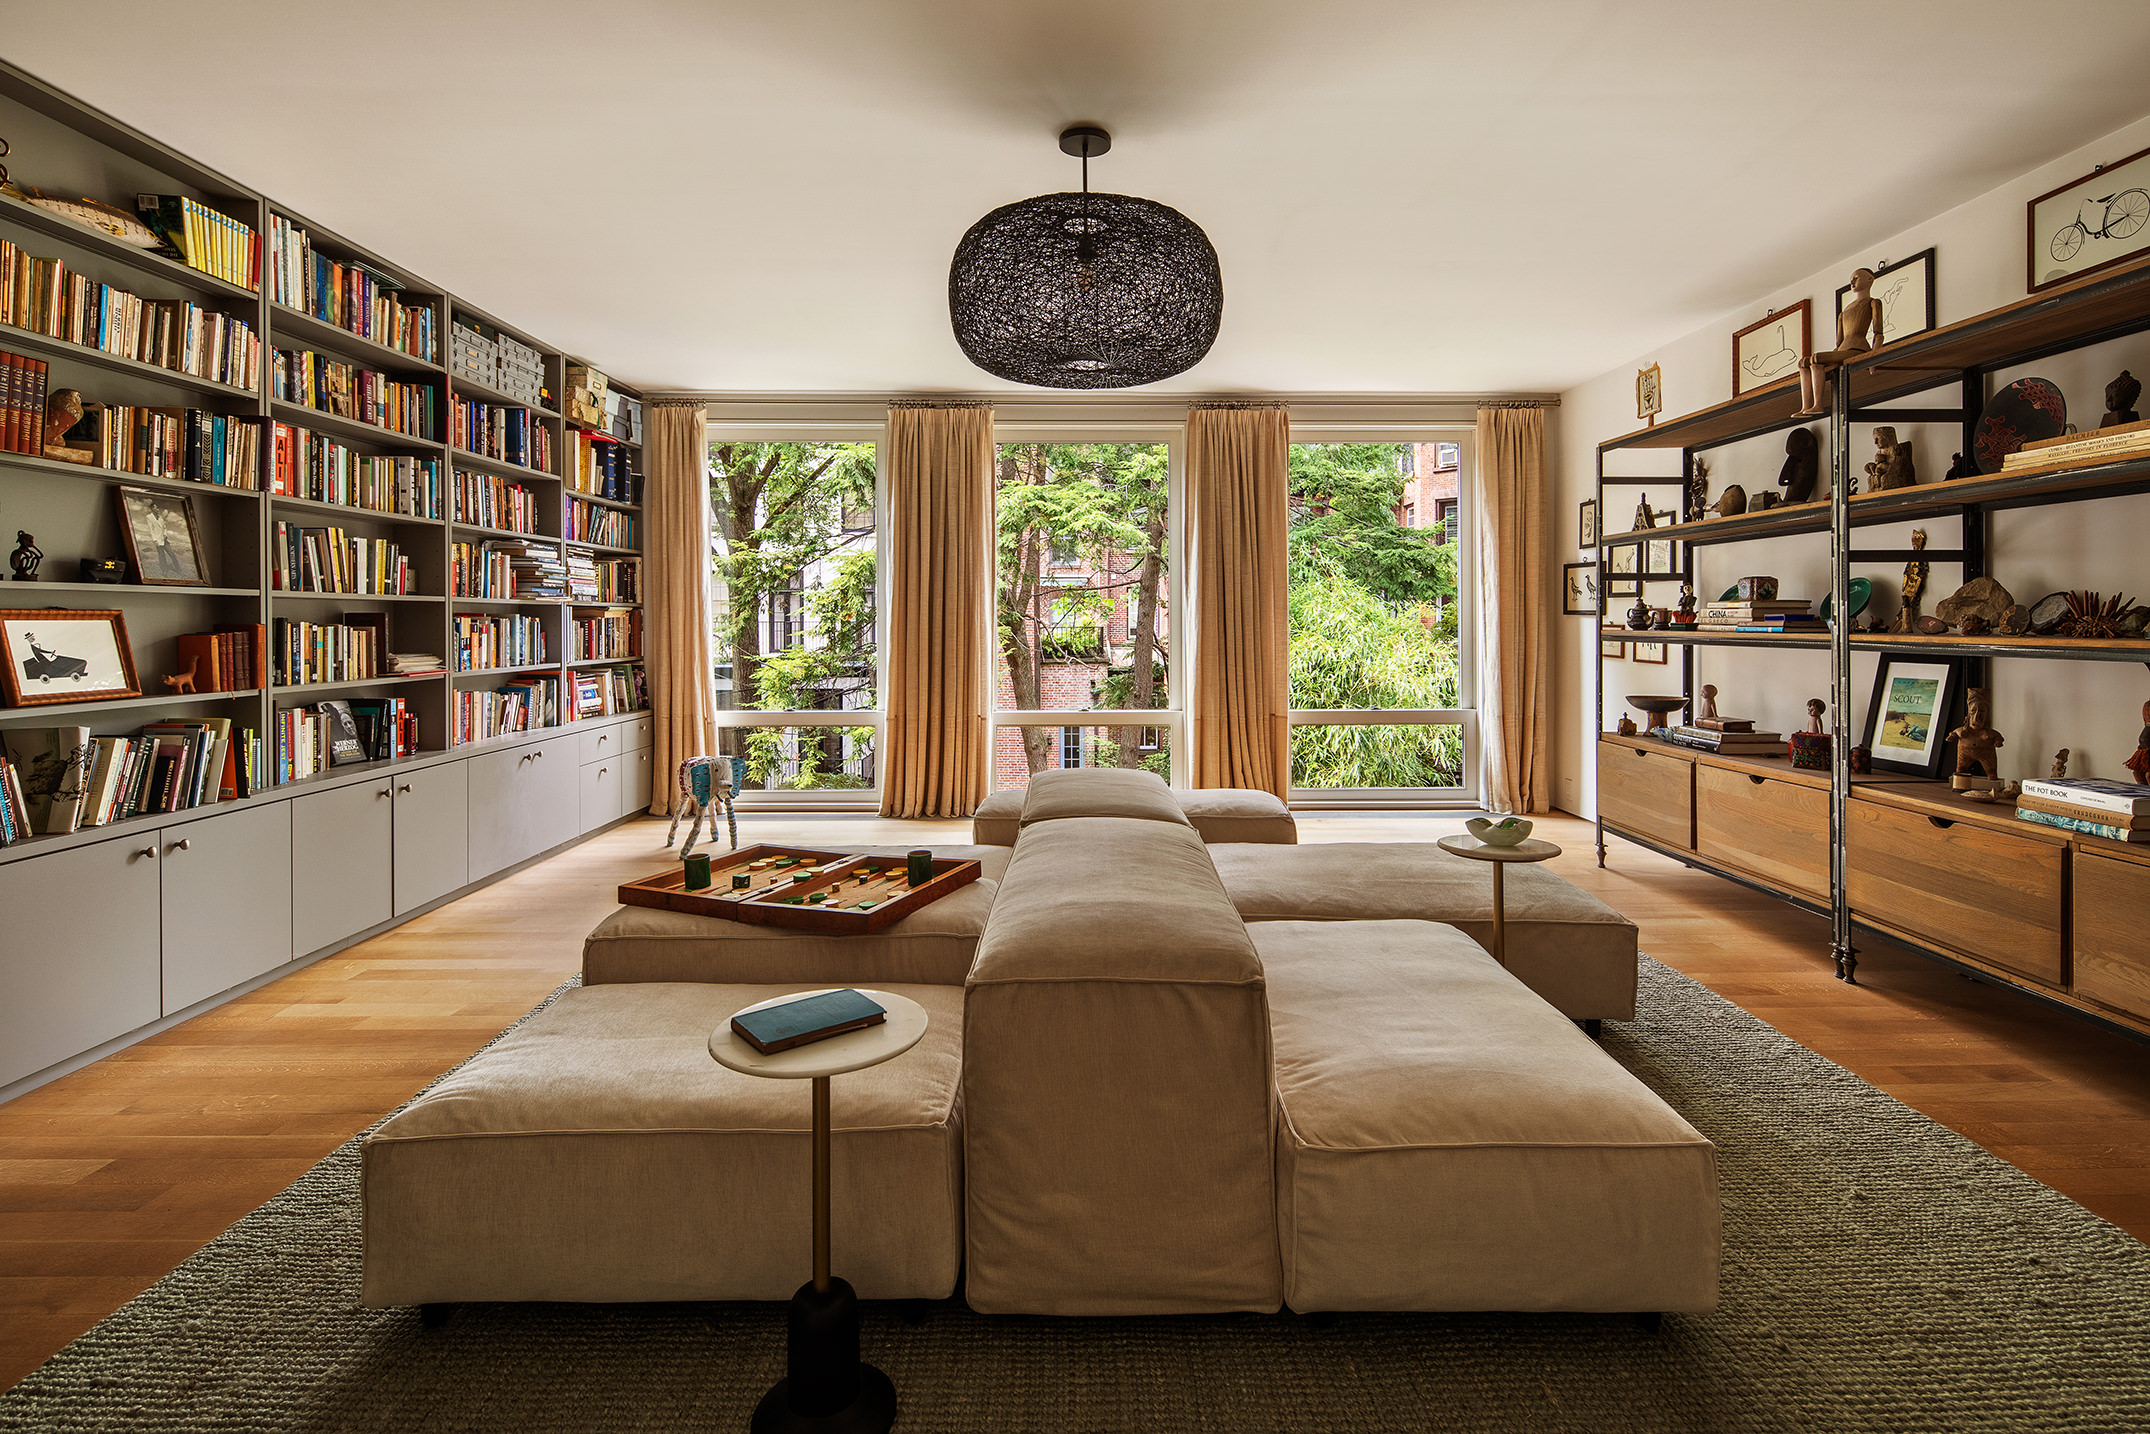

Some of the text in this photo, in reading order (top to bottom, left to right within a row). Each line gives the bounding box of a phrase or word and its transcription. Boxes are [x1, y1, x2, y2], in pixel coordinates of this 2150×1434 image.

[2066, 431, 2100, 441] DAUMIER
[1893, 694, 1922, 704] SCOUT
[2050, 790, 2068, 798] BOOK
